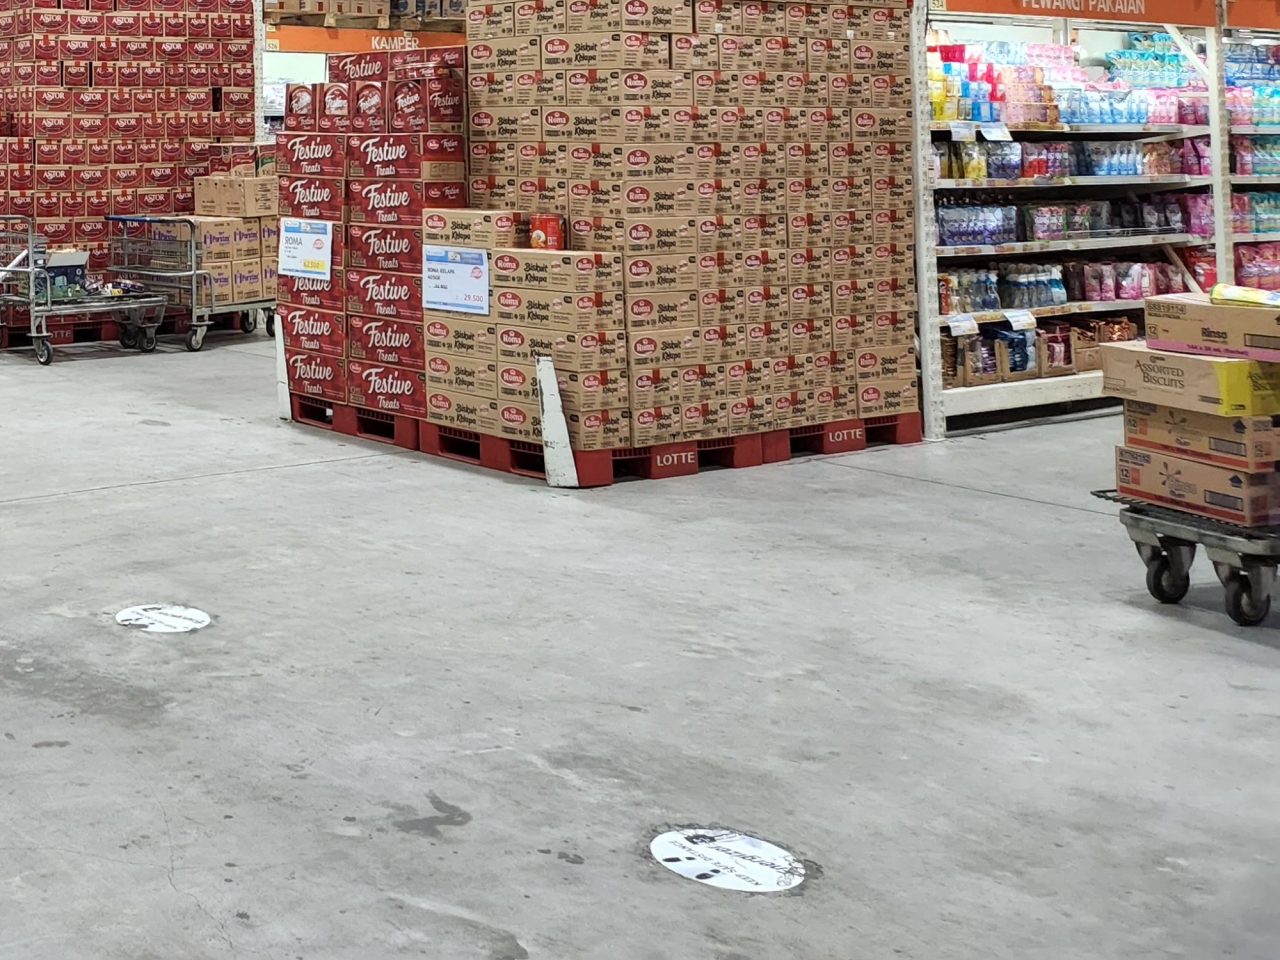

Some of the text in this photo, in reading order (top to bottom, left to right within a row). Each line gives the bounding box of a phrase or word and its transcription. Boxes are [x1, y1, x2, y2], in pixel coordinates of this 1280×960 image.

[40, 14, 62, 24] ASTOR
[76, 15, 99, 24] ASTOR
[112, 17, 134, 25] ASTOR
[161, 42, 182, 50] ASTOR
[372, 36, 419, 50] KAMPER
[42, 92, 65, 100] ASTOR
[185, 92, 207, 100] ASTOR
[397, 92, 420, 110] Festive
[429, 92, 461, 106] Festive
[287, 135, 333, 161] Festive
[360, 137, 407, 164] Festive
[629, 155, 647, 163] Roma
[42, 171, 66, 179] ASTOR
[151, 167, 172, 176] ASTOR
[374, 164, 396, 176] Treats
[289, 179, 331, 204] Festive
[301, 205, 320, 217] Treats
[376, 210, 398, 223] Treats
[428, 220, 444, 228] Roma
[285, 237, 303, 246] ROMA
[362, 229, 411, 256] Festive
[376, 257, 399, 269] Treats
[360, 274, 410, 301] Festive
[300, 293, 320, 306] Treats
[464, 294, 484, 303] 29.500
[499, 297, 520, 307] Roma
[374, 302, 397, 316] Treats
[287, 310, 332, 336] Festive
[362, 321, 412, 348] Festive
[429, 327, 448, 336] Roma
[1201, 327, 1228, 339] Rinso
[300, 337, 320, 349] Treats
[502, 335, 522, 345] Roma
[376, 349, 399, 363] Treats
[289, 355, 333, 381] Festive
[1135, 360, 1184, 377] ASSORTED
[362, 367, 414, 395] Festive
[503, 373, 524, 383] Roma
[1143, 372, 1185, 389] BISCUITS
[302, 381, 323, 394] Treats
[377, 396, 400, 410] Treats
[503, 411, 524, 422] Roma
[829, 428, 862, 442] LOTTE
[656, 452, 695, 467] LOTTE
